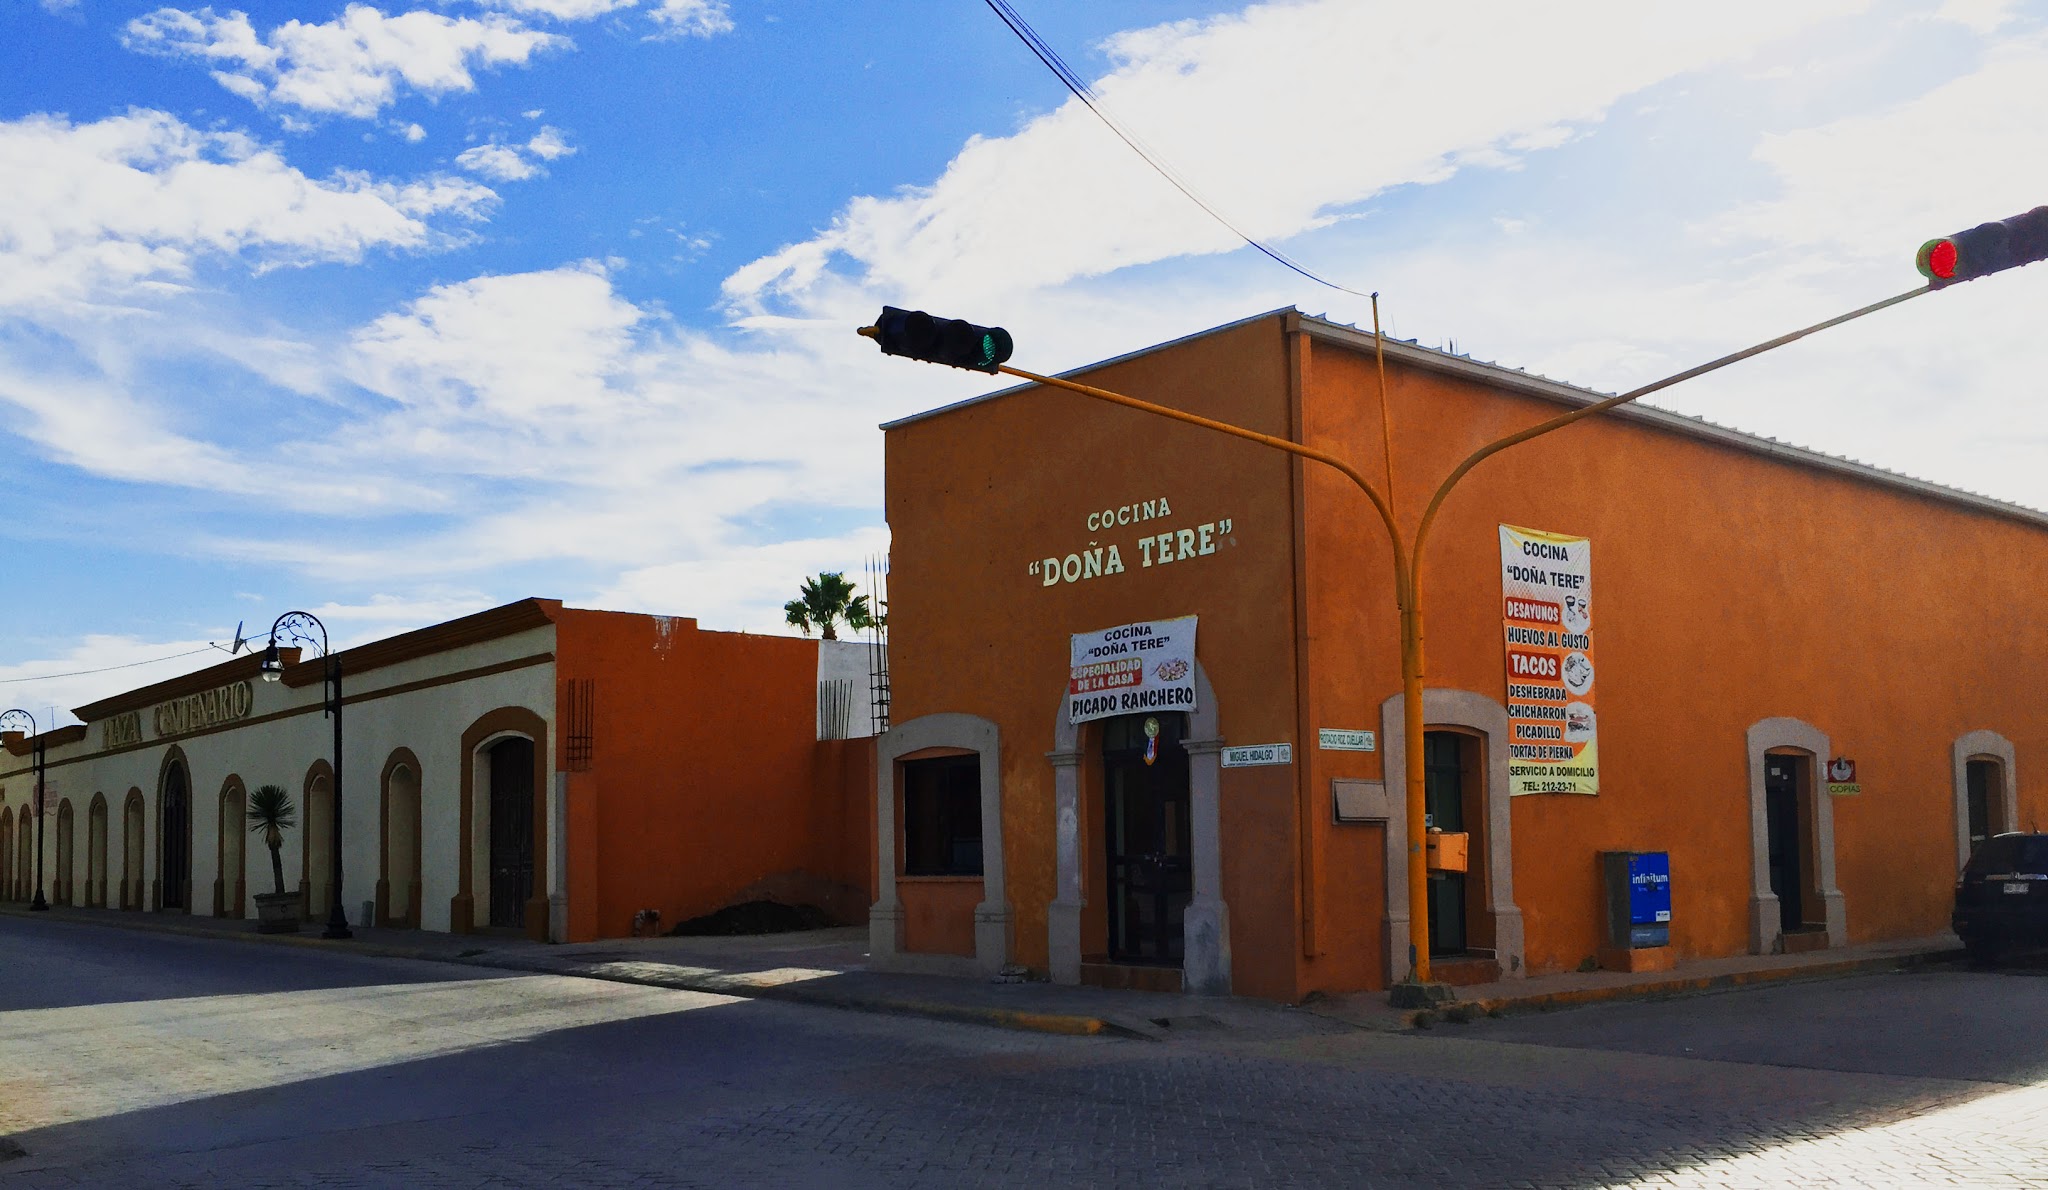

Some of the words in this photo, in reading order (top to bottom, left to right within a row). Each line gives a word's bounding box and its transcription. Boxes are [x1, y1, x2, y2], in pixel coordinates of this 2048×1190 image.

[1087, 497, 1171, 532] COCINA
[1523, 541, 1568, 561] COCINA
[1507, 601, 1559, 622] DESAYUNOS
[1104, 626, 1152, 641] COCINA
[1508, 627, 1545, 646] HUEVOS
[1547, 631, 1559, 647] AL
[1561, 633, 1589, 650] GUSTO
[1071, 659, 1141, 680] ESPECIALIDAD
[1511, 654, 1557, 677] TACOS
[1077, 680, 1090, 692] DE
[1092, 677, 1105, 690] LA
[1107, 672, 1135, 687] CASA
[1509, 684, 1567, 701] DESHEBRADA
[153, 681, 252, 736] CENTENARIO
[1072, 695, 1117, 717] PICADO
[1121, 686, 1194, 710] RANCHERO
[1508, 704, 1567, 720] CHICHARRON
[1516, 725, 1561, 739] PICADILLO
[1229, 751, 1249, 762] MIGUEL
[1249, 749, 1274, 761] HIDALGO
[1509, 744, 1537, 758] TORTAS
[1538, 746, 1547, 758] DE
[1549, 745, 1574, 760] PIERNA
[1509, 766, 1547, 777] SERVICIO
[1549, 767, 1555, 777] A
[1556, 767, 1595, 778] DOMICILIO
[1522, 782, 1540, 792] TEL:
[1541, 781, 1577, 792] 212-23-71
[1829, 785, 1861, 793] COPIAS
[1632, 873, 1668, 884] infinitum
